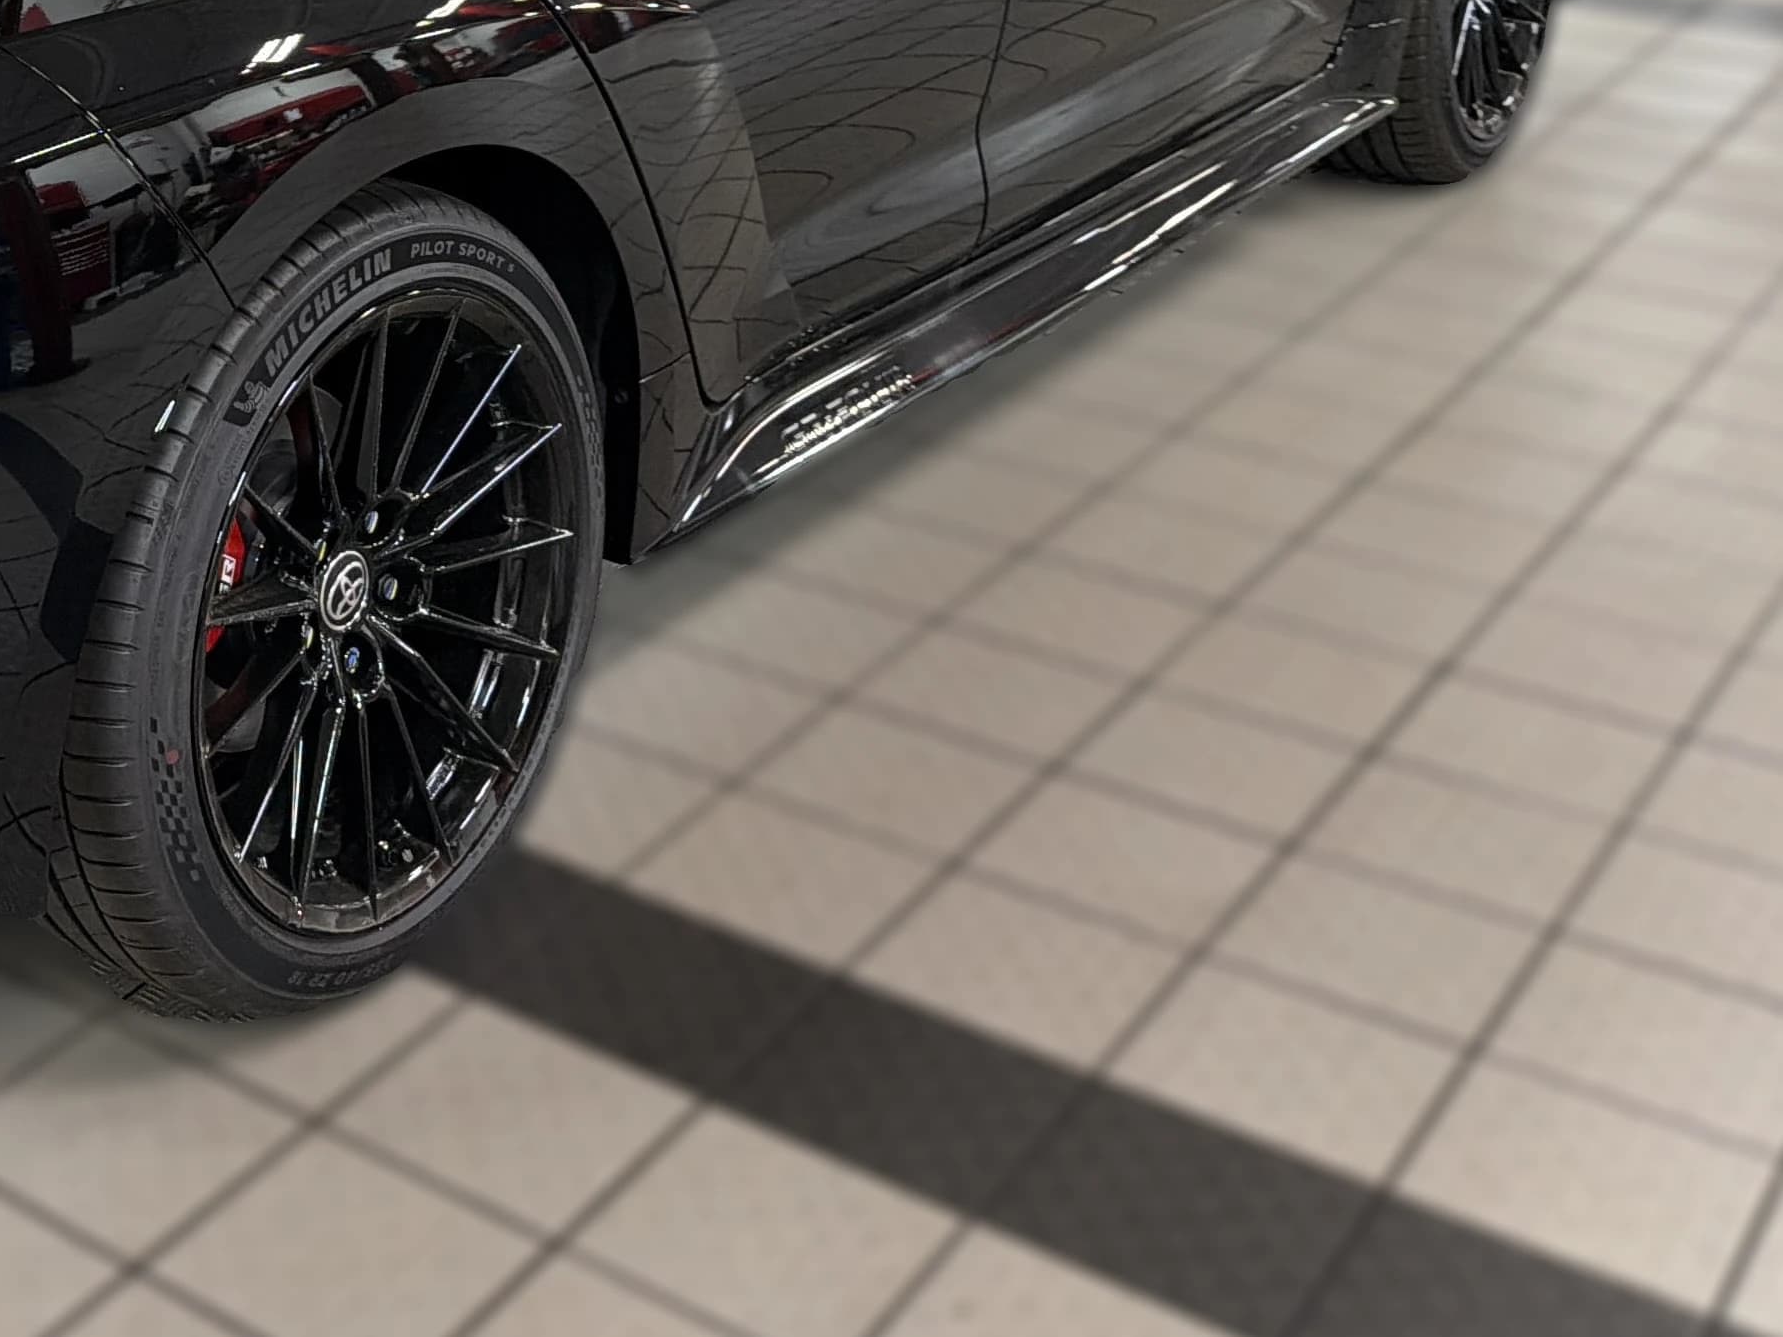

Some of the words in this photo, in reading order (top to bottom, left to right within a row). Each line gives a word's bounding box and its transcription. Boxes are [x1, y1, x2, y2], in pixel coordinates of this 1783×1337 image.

[410, 240, 455, 259] PILOT
[458, 242, 506, 269] SPORT
[264, 248, 392, 378] MICHELIN
